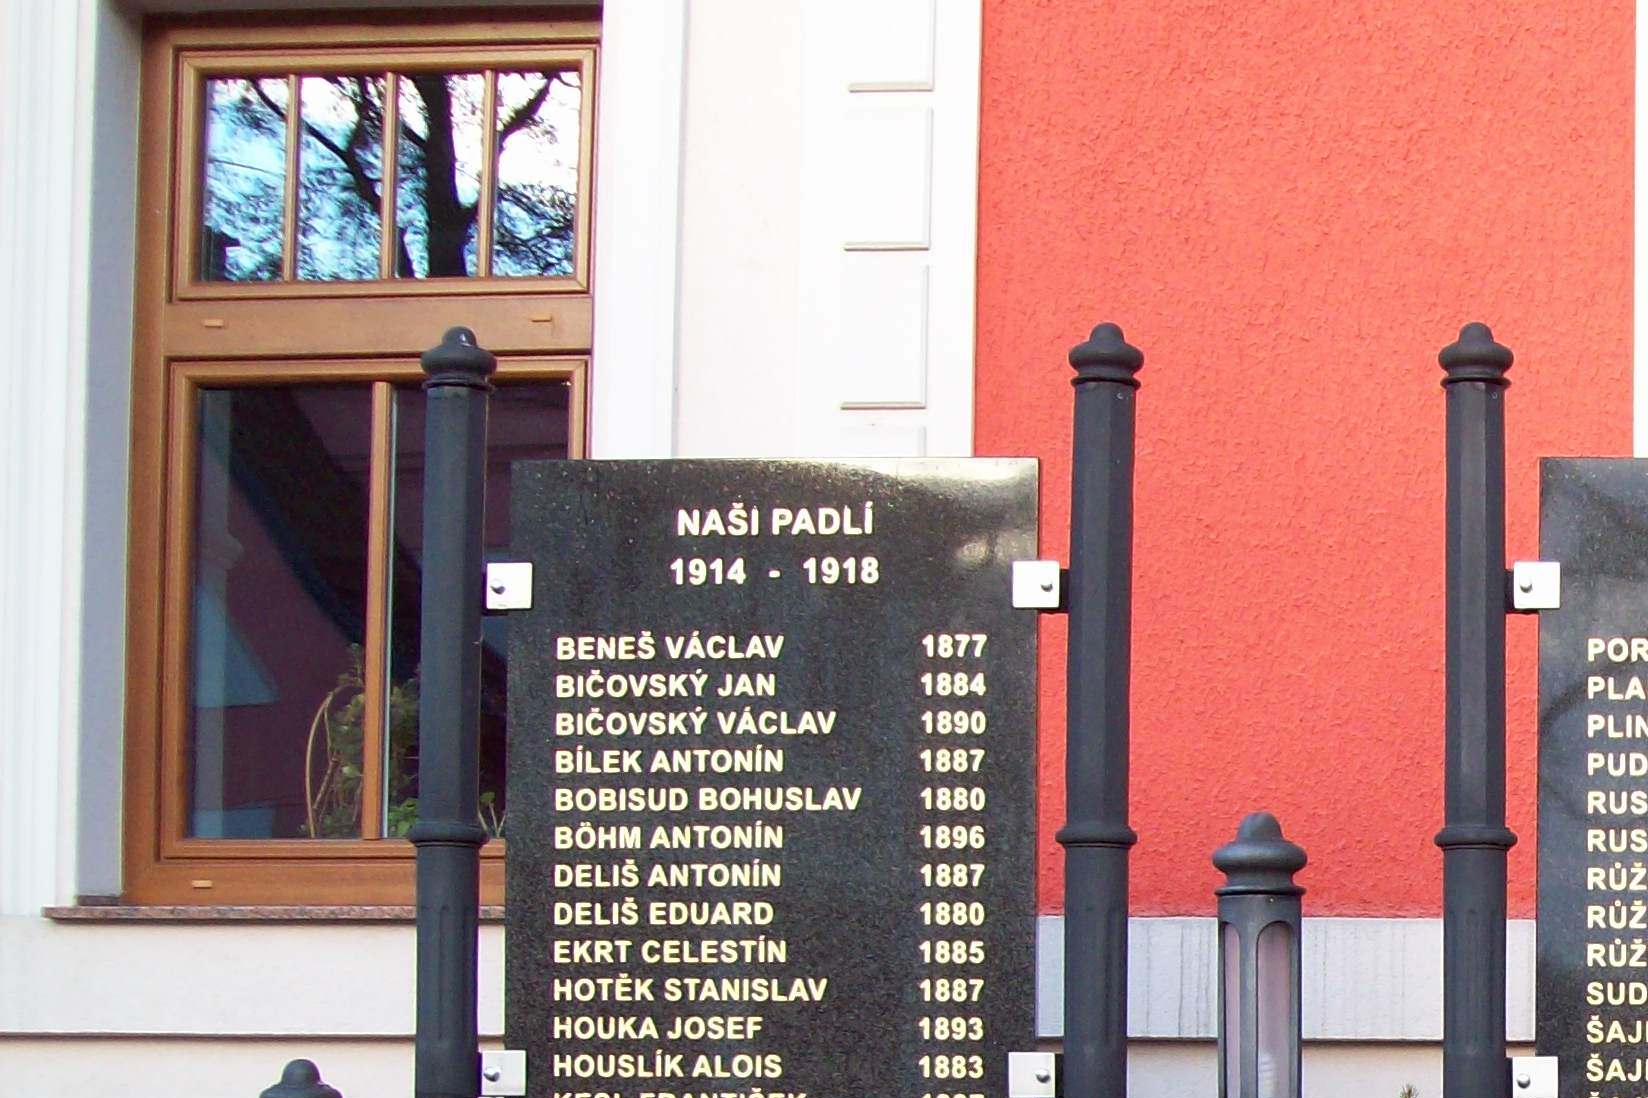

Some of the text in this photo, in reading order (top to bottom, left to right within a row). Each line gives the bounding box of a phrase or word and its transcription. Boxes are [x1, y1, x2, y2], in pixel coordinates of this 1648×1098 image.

[677, 500, 874, 537] NAŠI PADLÍ
[670, 557, 747, 586] 1914
[802, 556, 879, 585] 1918
[556, 630, 988, 661] BENEŠ VÁCLAV 1877
[556, 668, 987, 698] BIČOVSKÝ JAN 1884
[555, 706, 987, 736] BIČOVSKÝ VÁCLAV 1890
[555, 743, 985, 774] BÍLEK ANTONÍN 1887
[555, 786, 986, 812] BOBISUD BOHUSLAV 1880
[554, 819, 985, 850] BÖHM ANTONÍN 1896
[553, 896, 985, 926] DELIŠ EDUARD 1880
[553, 934, 985, 965] EKRT CELESTÍN 1885
[553, 972, 985, 1003] HOTĚK STANISLAV 1887
[553, 1015, 984, 1041] HOUKA JOSEF 1893
[553, 1049, 984, 1079] HOUSLÍK ALOIS 1883
